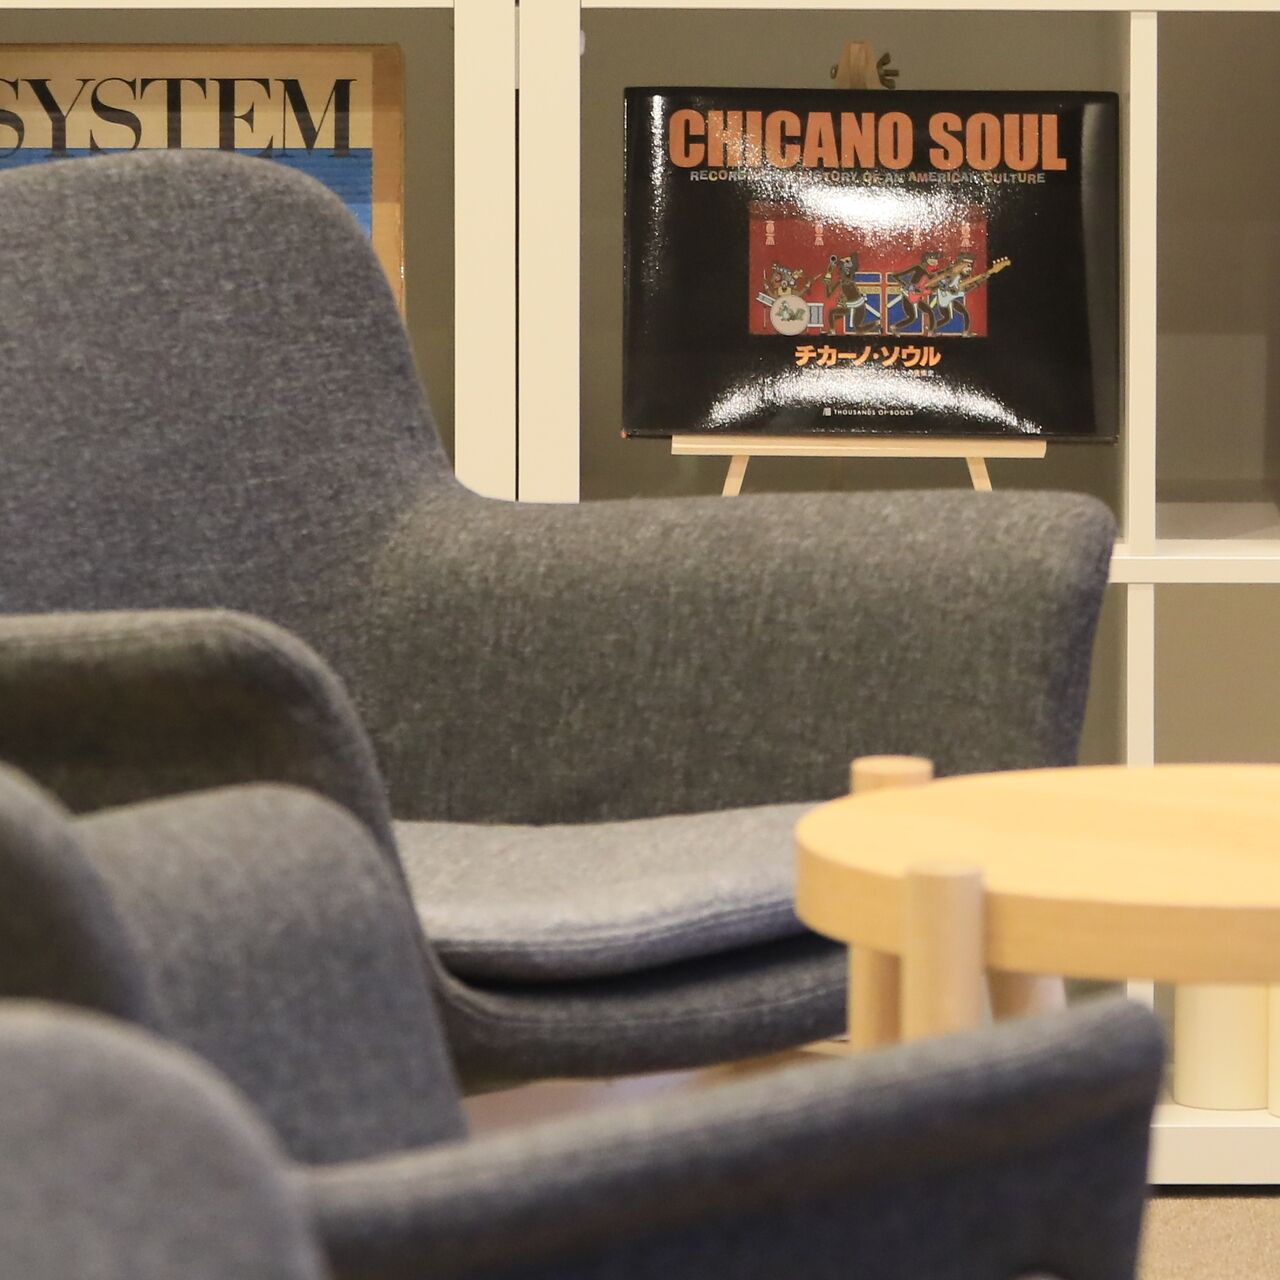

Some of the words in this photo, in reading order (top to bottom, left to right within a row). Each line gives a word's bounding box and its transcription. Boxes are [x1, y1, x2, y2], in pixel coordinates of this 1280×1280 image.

[669, 108, 914, 169] CHICANO
[929, 112, 1067, 171] SOUL
[794, 345, 941, 368] チカーノ・ソウル
[834, 408, 877, 416] THOUSANDS
[888, 408, 914, 416] BOOKS
